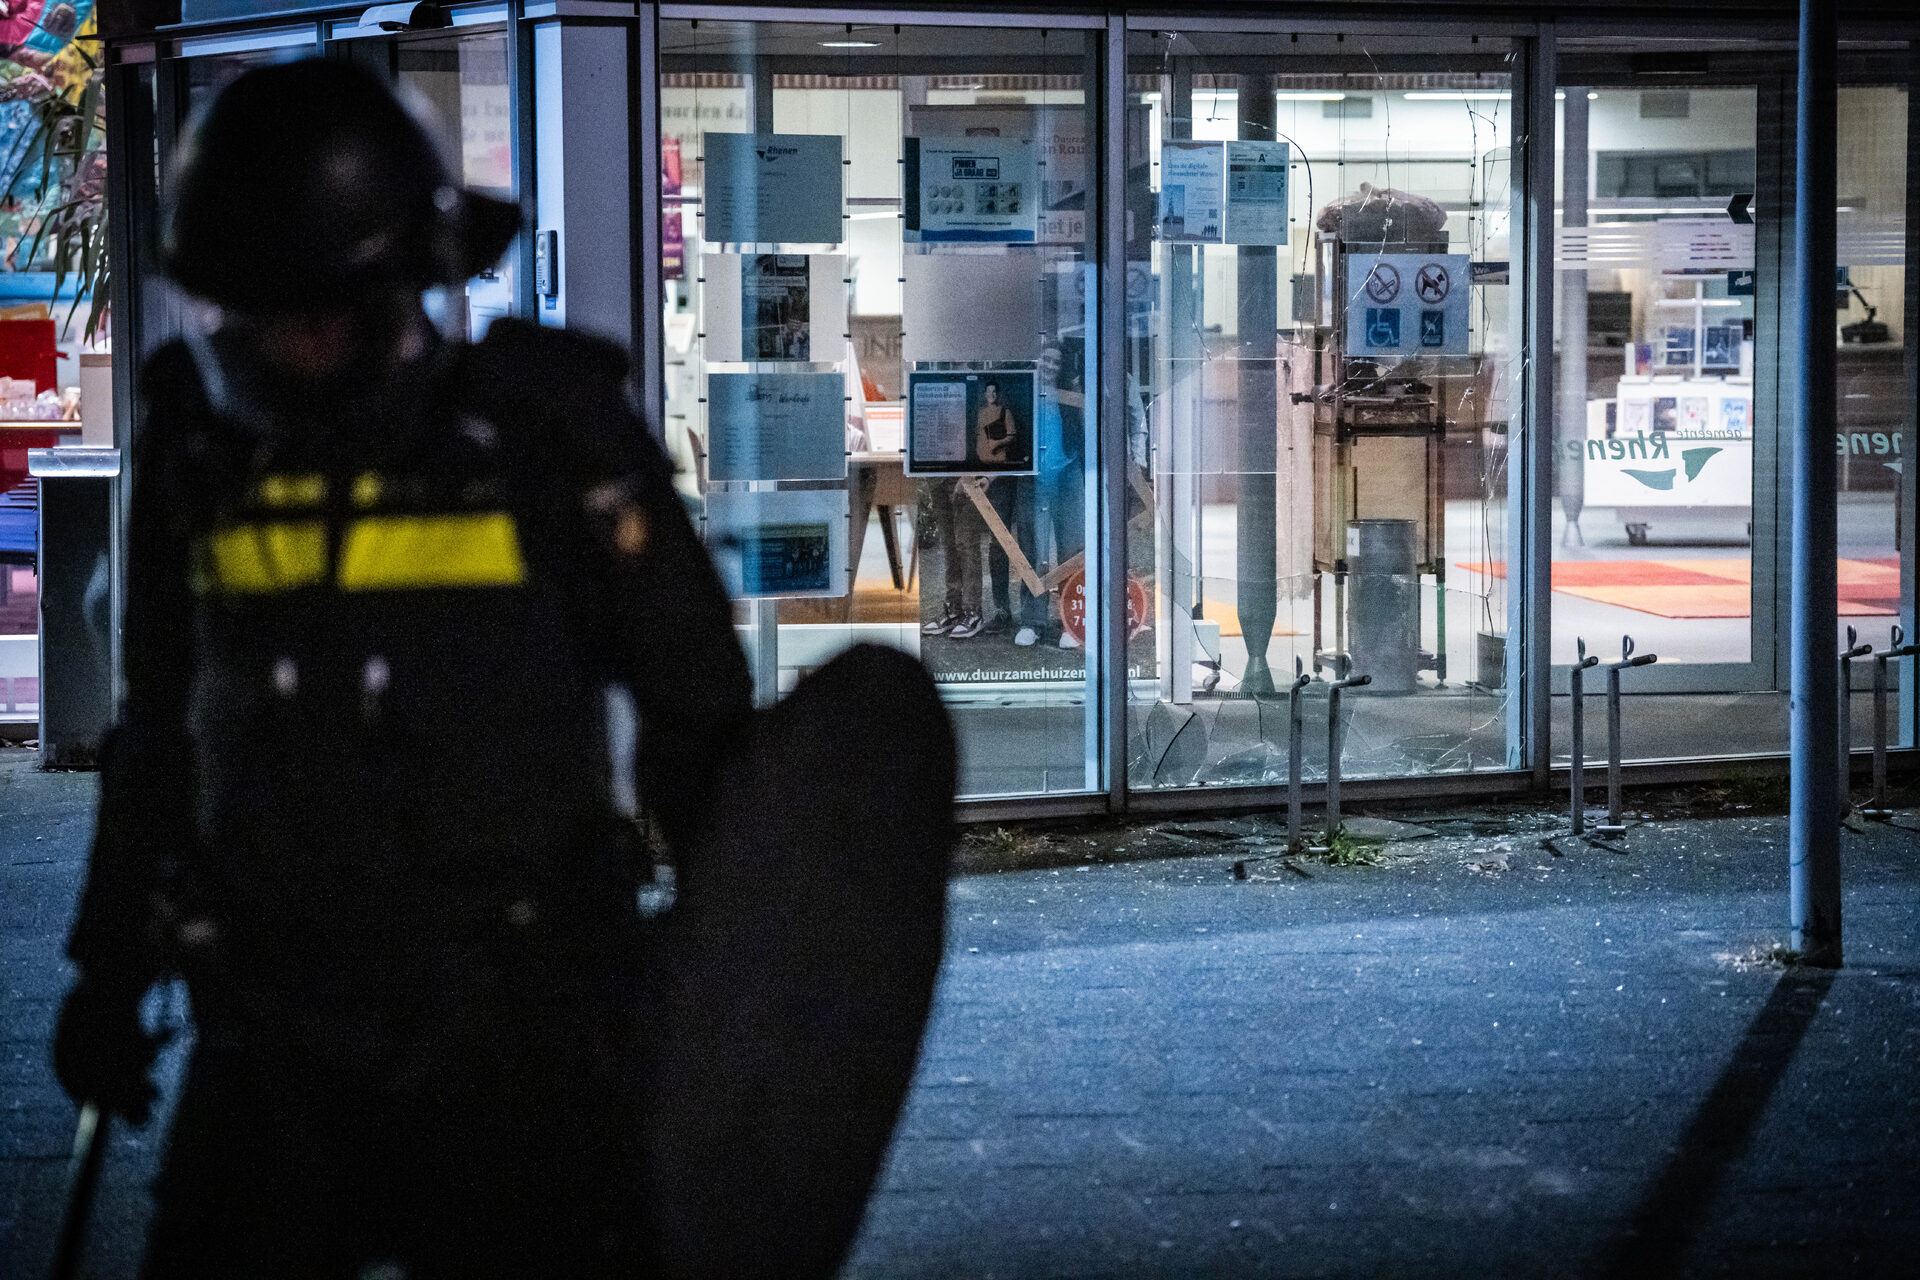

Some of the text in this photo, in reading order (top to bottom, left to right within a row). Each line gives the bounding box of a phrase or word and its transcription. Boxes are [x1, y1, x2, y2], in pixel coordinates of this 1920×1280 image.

[1071, 599, 1083, 610] 31
[1074, 615, 1080, 627] 7
[933, 664, 1141, 682] www.duurzamehuizennl
